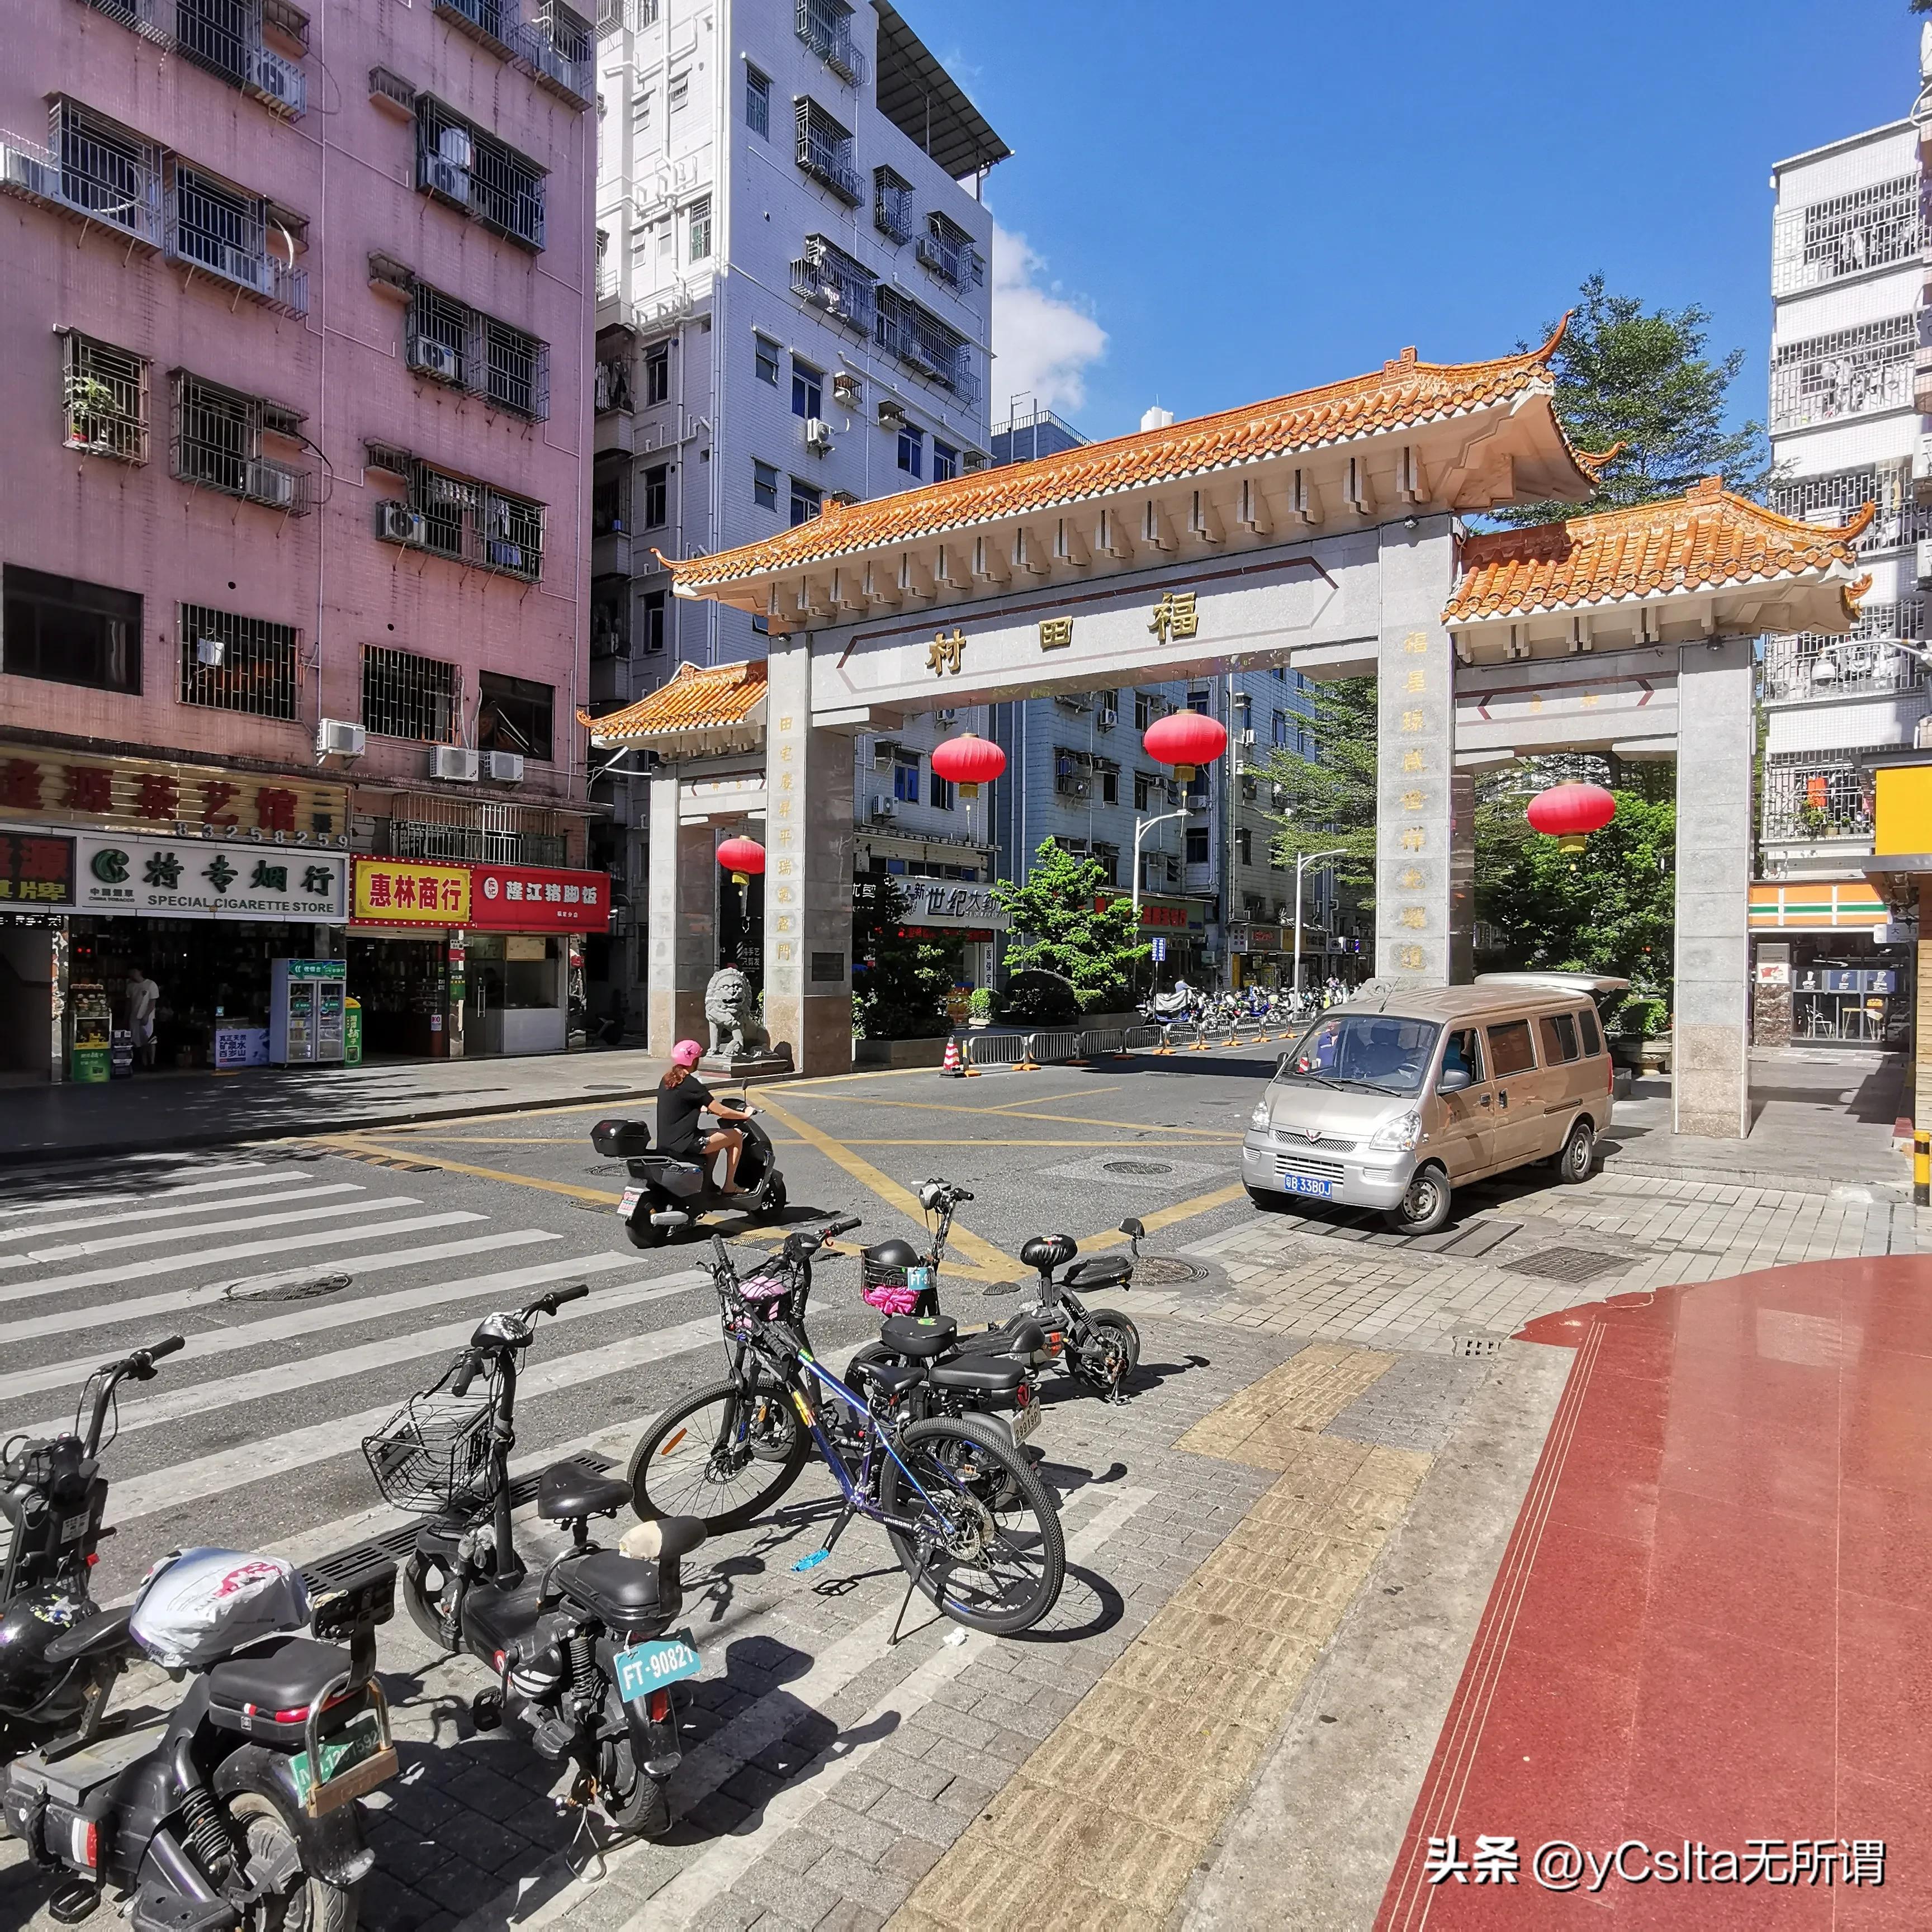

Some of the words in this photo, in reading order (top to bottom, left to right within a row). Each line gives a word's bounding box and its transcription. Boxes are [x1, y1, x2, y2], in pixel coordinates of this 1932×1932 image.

[369, 872, 462, 912] 惠林商行
[506, 880, 597, 905] 隆江猪脚饭
[148, 895, 211, 908] SPECIAL
[214, 898, 290, 911] CIGARETTE
[292, 902, 334, 913] STORE
[219, 1041, 247, 1050] 矿泉水
